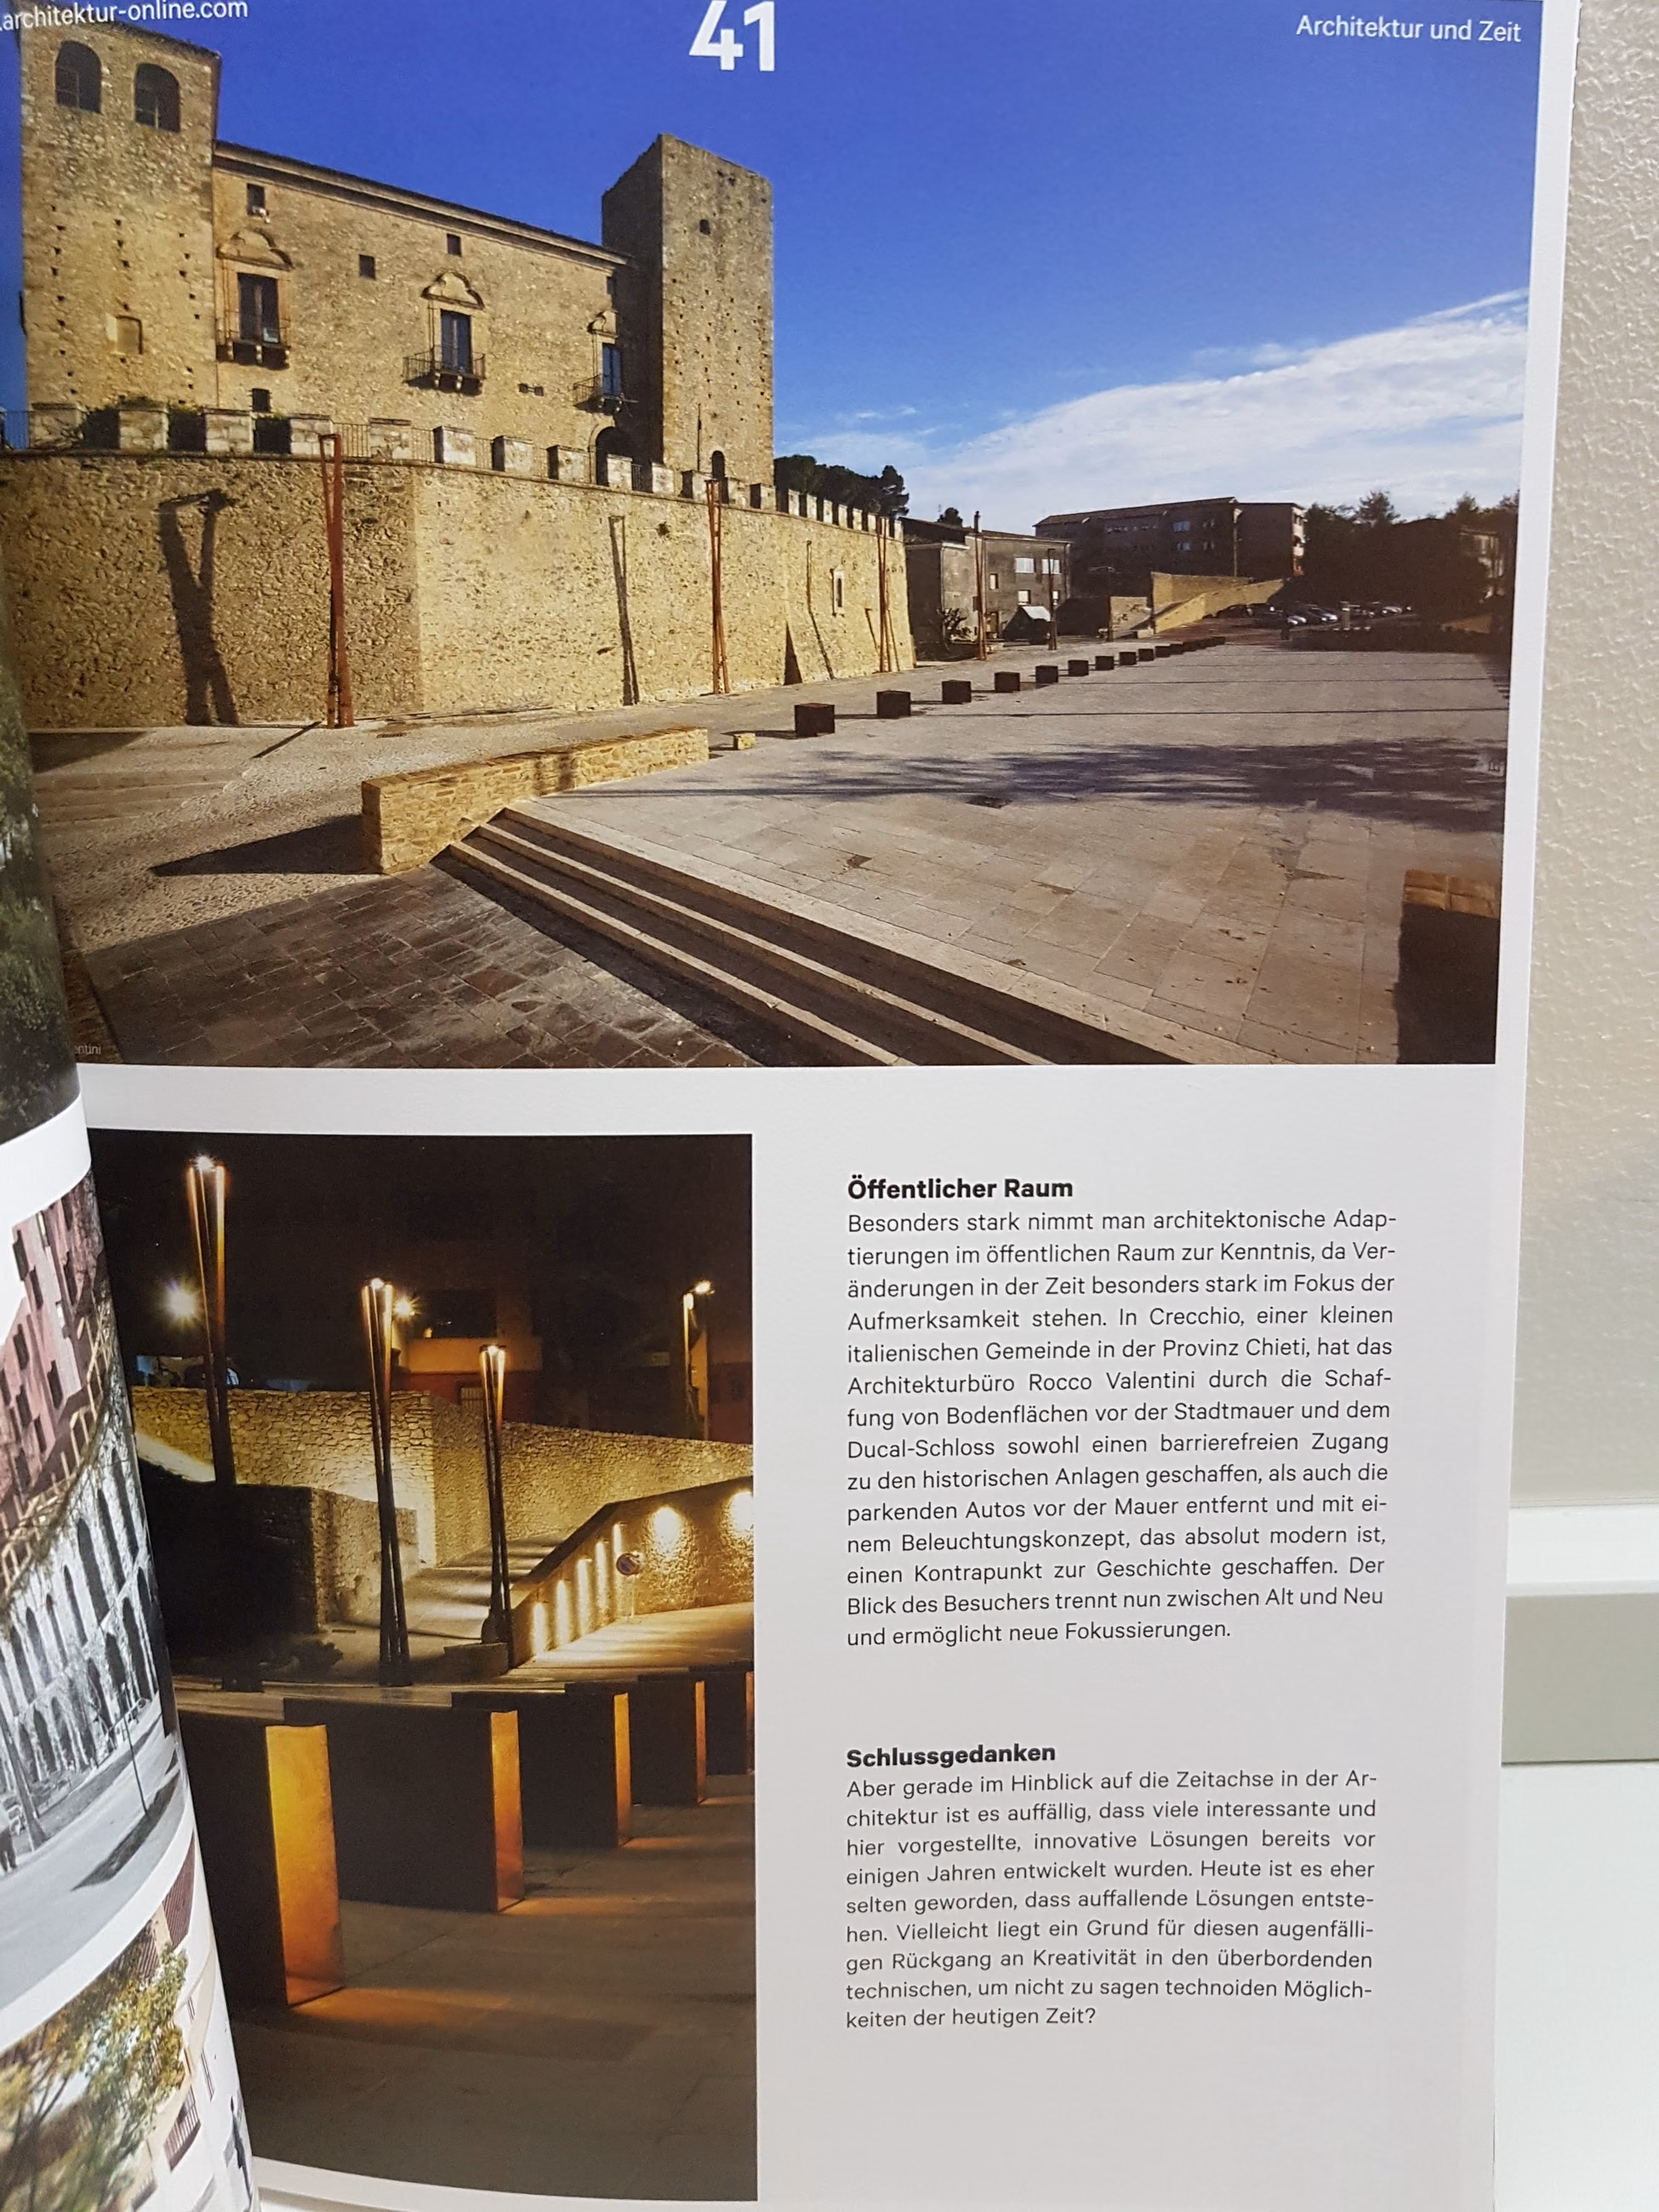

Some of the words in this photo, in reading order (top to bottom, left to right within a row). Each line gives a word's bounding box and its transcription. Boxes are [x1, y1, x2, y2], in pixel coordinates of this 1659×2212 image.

[689, 0, 775, 71] 41
[1296, 14, 1423, 38] Architektur
[1430, 19, 1472, 41] und
[1478, 20, 1521, 43] Zeit
[847, 1173, 998, 1200] Öffentlicher
[1004, 1177, 1074, 1198] Raum
[848, 1211, 959, 1233] Besonders
[966, 1211, 1020, 1231] stark
[1028, 1211, 1094, 1230] nimmt
[1102, 1215, 1145, 1229] man
[1153, 1208, 1326, 1229] architektonische
[1332, 1208, 1397, 1232] Adap-
[847, 1246, 949, 1269] tierungen
[956, 1245, 980, 1264] im
[986, 1243, 1110, 1263] öffentlichen
[1117, 1243, 1175, 1263] Raum
[1181, 1246, 1215, 1261] zur
[1221, 1241, 1315, 1263] Kenntnis,
[1321, 1240, 1346, 1260] da
[1352, 1241, 1396, 1260] Ver-
[847, 1278, 974, 1302] änderungen
[981, 1277, 999, 1297] in
[1005, 1276, 1040, 1296] der
[1045, 1276, 1086, 1295] Zeit
[1092, 1274, 1200, 1295] besonders
[1205, 1273, 1258, 1293] stark
[1263, 1274, 1287, 1292] im
[1294, 1273, 1355, 1292] Fokus
[1360, 1272, 1395, 1291] der
[847, 1308, 1020, 1331] Aufmerksamkeit
[1032, 1308, 1107, 1327] stehen.
[1120, 1308, 1137, 1326] In
[1149, 1305, 1245, 1327] Crecchio,
[1257, 1306, 1308, 1325] einer
[1320, 1304, 1393, 1324] kleinen
[847, 1342, 978, 1363] italienischen
[985, 1339, 1091, 1360] Gemeinde
[1097, 1340, 1115, 1359] in
[1121, 1338, 1157, 1358] der
[1163, 1338, 1240, 1357] Provinz
[1246, 1337, 1310, 1359] Chieti,
[1317, 1337, 1350, 1356] hat
[1356, 1336, 1393, 1355] das
[847, 1373, 1015, 1395] Architekturbüro
[1029, 1373, 1092, 1392] Rocco
[1105, 1370, 1195, 1390] Valentini
[1208, 1368, 1268, 1388] durch
[1280, 1368, 1312, 1388] die
[1325, 1367, 1392, 1388] Schaf-
[847, 1408, 894, 1431] fung
[901, 1411, 939, 1426] von
[947, 1404, 1088, 1425] Bodenflächen
[1094, 1407, 1128, 1422] vor
[1134, 1401, 1169, 1421] der
[1174, 1400, 1295, 1421] Stadtmauer
[1301, 1400, 1340, 1419] und
[1346, 1400, 1390, 1419] dem
[847, 1437, 995, 1459] Ducal-Schloss
[1007, 1434, 1079, 1456] sowohl
[1092, 1434, 1148, 1453] einen
[1160, 1432, 1298, 1452] barrierefreien
[1311, 1432, 1388, 1455] Zugang
[847, 1476, 871, 1491] zu
[877, 1470, 916, 1490] den
[923, 1468, 1049, 1489] historischen
[1054, 1466, 1139, 1489] Anlagen
[1145, 1463, 1263, 1488] geschaffen,
[1268, 1462, 1297, 1482] als
[1302, 1462, 1351, 1482] auch
[1358, 1462, 1388, 1481] die
[847, 1538, 891, 1554] nem
[902, 1529, 1131, 1554] Beleuchtungskonzept,
[1139, 1527, 1176, 1546] das
[1184, 1525, 1260, 1546] absolut
[1269, 1525, 1347, 1544] modern
[1357, 1525, 1386, 1546] ist,
[847, 1566, 903, 1584] einen
[915, 1560, 1043, 1585] Kontrapunkt
[1053, 1565, 1086, 1579] zur
[1097, 1558, 1211, 1578] Geschichte
[1222, 1555, 1338, 1580] geschaffen.
[1349, 1556, 1385, 1574] Der
[847, 1595, 897, 1616] Blick
[902, 1594, 938, 1614] des
[944, 1592, 1050, 1613] Besuchers
[1054, 1592, 1118, 1610] trennt
[1123, 1593, 1161, 1608] nun
[1166, 1588, 1260, 1607] zwischen
[1264, 1587, 1294, 1605] Alt
[1299, 1586, 1337, 1605] und
[1343, 1587, 1383, 1605] Neu
[847, 1627, 886, 1646] und
[892, 1623, 1002, 1648] ermöglicht
[1009, 1627, 1059, 1641] neue
[1065, 1621, 1231, 1642] Fokussierungen.
[846, 1742, 1056, 1770] Schlussgedanken
[846, 1779, 896, 1798] Aber
[903, 1776, 973, 1800] gerade
[980, 1776, 1003, 1793] im
[1011, 1771, 1093, 1793] Hinblick
[1100, 1770, 1133, 1790] auf
[1138, 1770, 1170, 1789] die
[1176, 1769, 1274, 1788] Zeitachse
[1281, 1770, 1298, 1787] in
[1305, 1768, 1339, 1787] der
[1345, 1769, 1377, 1787] Ar-
[847, 1807, 939, 1827] chitektur
[946, 1806, 970, 1824] ist
[978, 1809, 1000, 1822] es
[1007, 1802, 1092, 1824] auffällig,
[1098, 1800, 1145, 1819] dass
[1152, 1799, 1199, 1818] viele
[1206, 1799, 1331, 1818] interessante
[1338, 1799, 1377, 1817] und
[847, 1839, 886, 1856] hier
[897, 1833, 1021, 1857] vorgestellte,
[1034, 1831, 1137, 1850] innovative
[1150, 1830, 1248, 1851] Lösungen
[1262, 1828, 1331, 1848] bereits
[1343, 1833, 1377, 1848] vor
[846, 1896, 907, 1914] selten
[914, 1891, 1018, 1916] geworden,
[1024, 1890, 1071, 1908] dass
[1078, 1888, 1189, 1907] auffallende
[1195, 1889, 1294, 1911] Lösungen
[1301, 1891, 1374, 1908] entste-
[847, 1925, 888, 1943] hen.
[896, 1920, 989, 1941] Vielleicht
[997, 1920, 1040, 1941] liegt
[1048, 1919, 1078, 1937] ein
[1086, 1918, 1149, 1936] Grund
[1157, 1918, 1186, 1936] für
[1193, 1918, 1259, 1937] diesen
[1267, 1918, 1374, 1941] augenfälli-
[846, 1958, 883, 1976] gen
[892, 1951, 991, 1972] Rückgang
[1000, 1953, 1023, 1967] an
[1033, 1948, 1137, 1966] Kreativität
[1146, 1948, 1163, 1966] in
[1172, 1947, 1208, 1966] den
[1217, 1948, 1372, 1969] überbordenden
[846, 1979, 972, 2000] technischen,
[978, 1982, 1008, 1996] um
[1015, 1977, 1064, 1995] nicht
[1070, 1981, 1093, 1995] zu
[1099, 1981, 1159, 1999] sagen
[1165, 1977, 1277, 1997] technoiden
[1284, 1979, 1372, 2002] Möglich-
